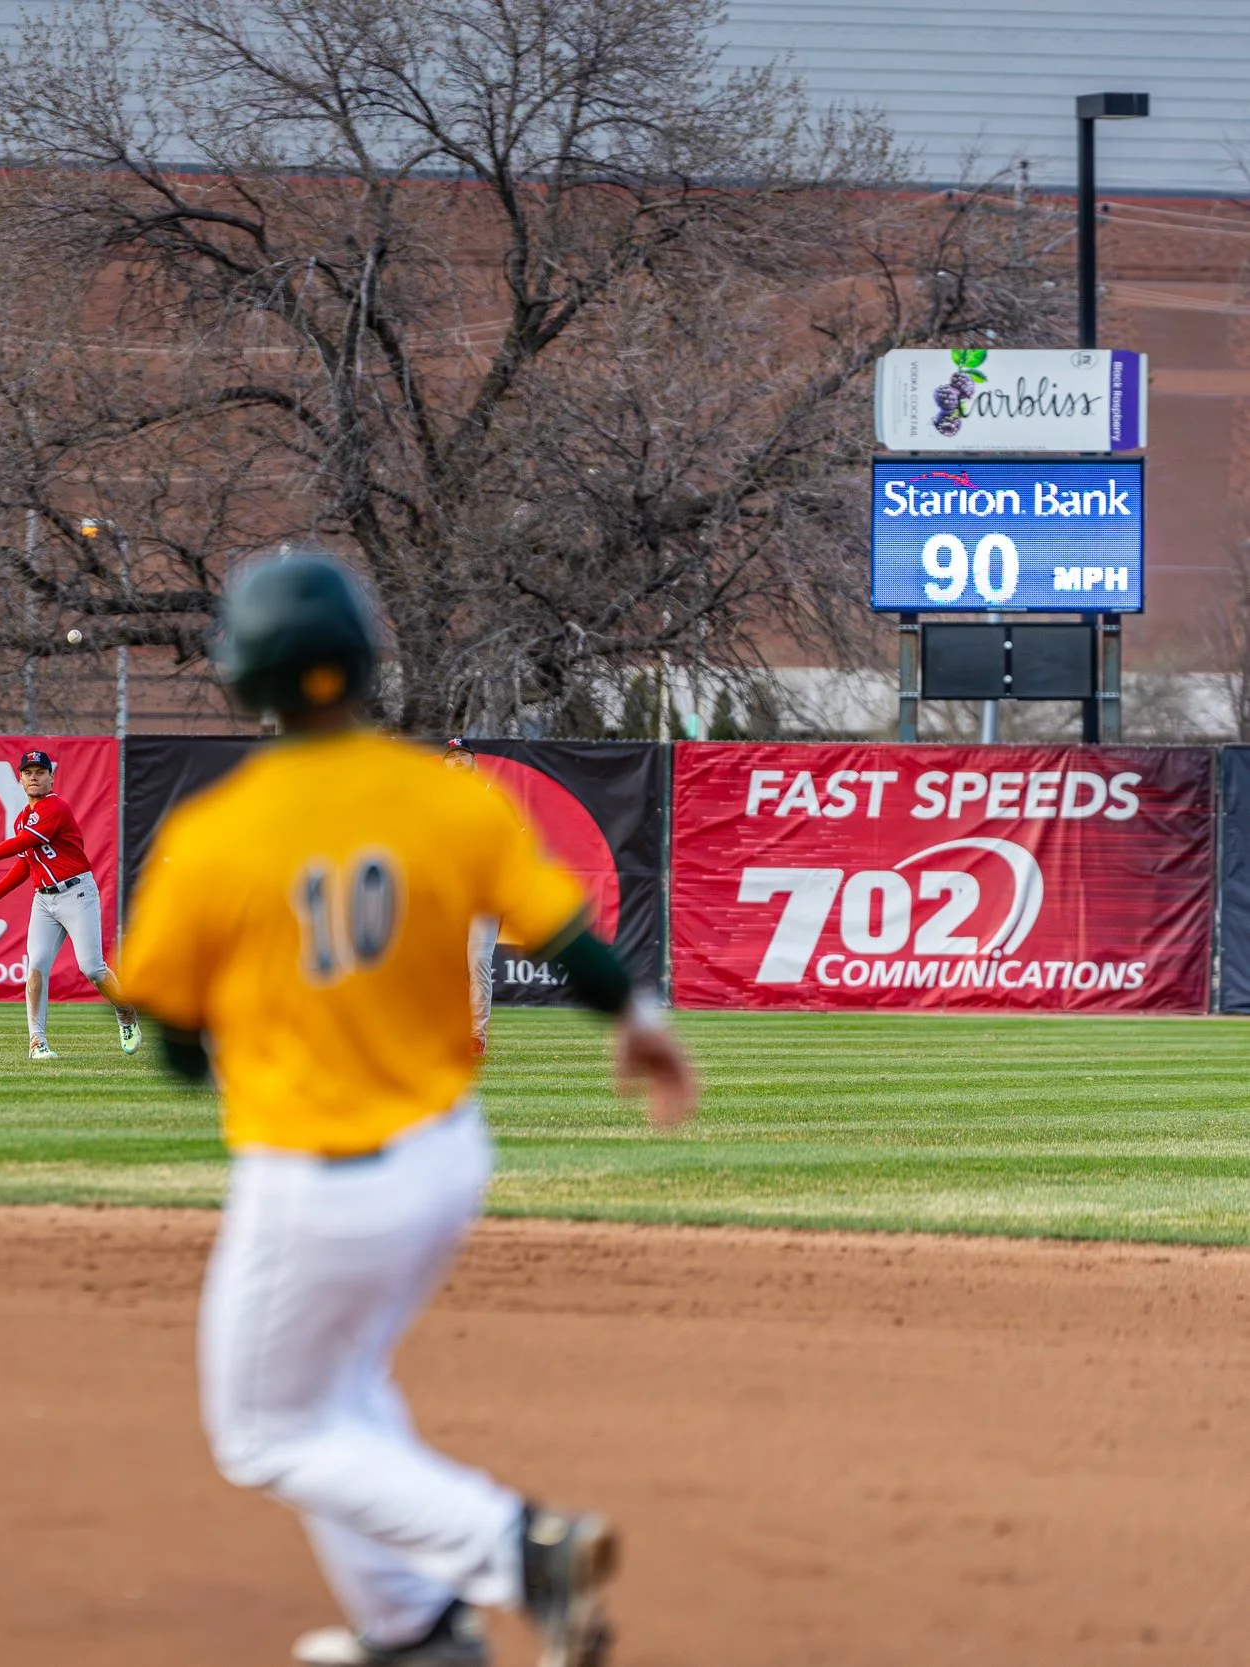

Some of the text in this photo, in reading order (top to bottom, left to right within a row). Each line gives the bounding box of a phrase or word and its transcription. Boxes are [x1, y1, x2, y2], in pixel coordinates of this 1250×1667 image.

[883, 480, 1132, 517] Starion Bank
[921, 533, 1128, 604] 90 MPH
[744, 769, 1143, 821] FAST SPEEDS
[287, 846, 407, 988] 10
[737, 867, 982, 984] 702
